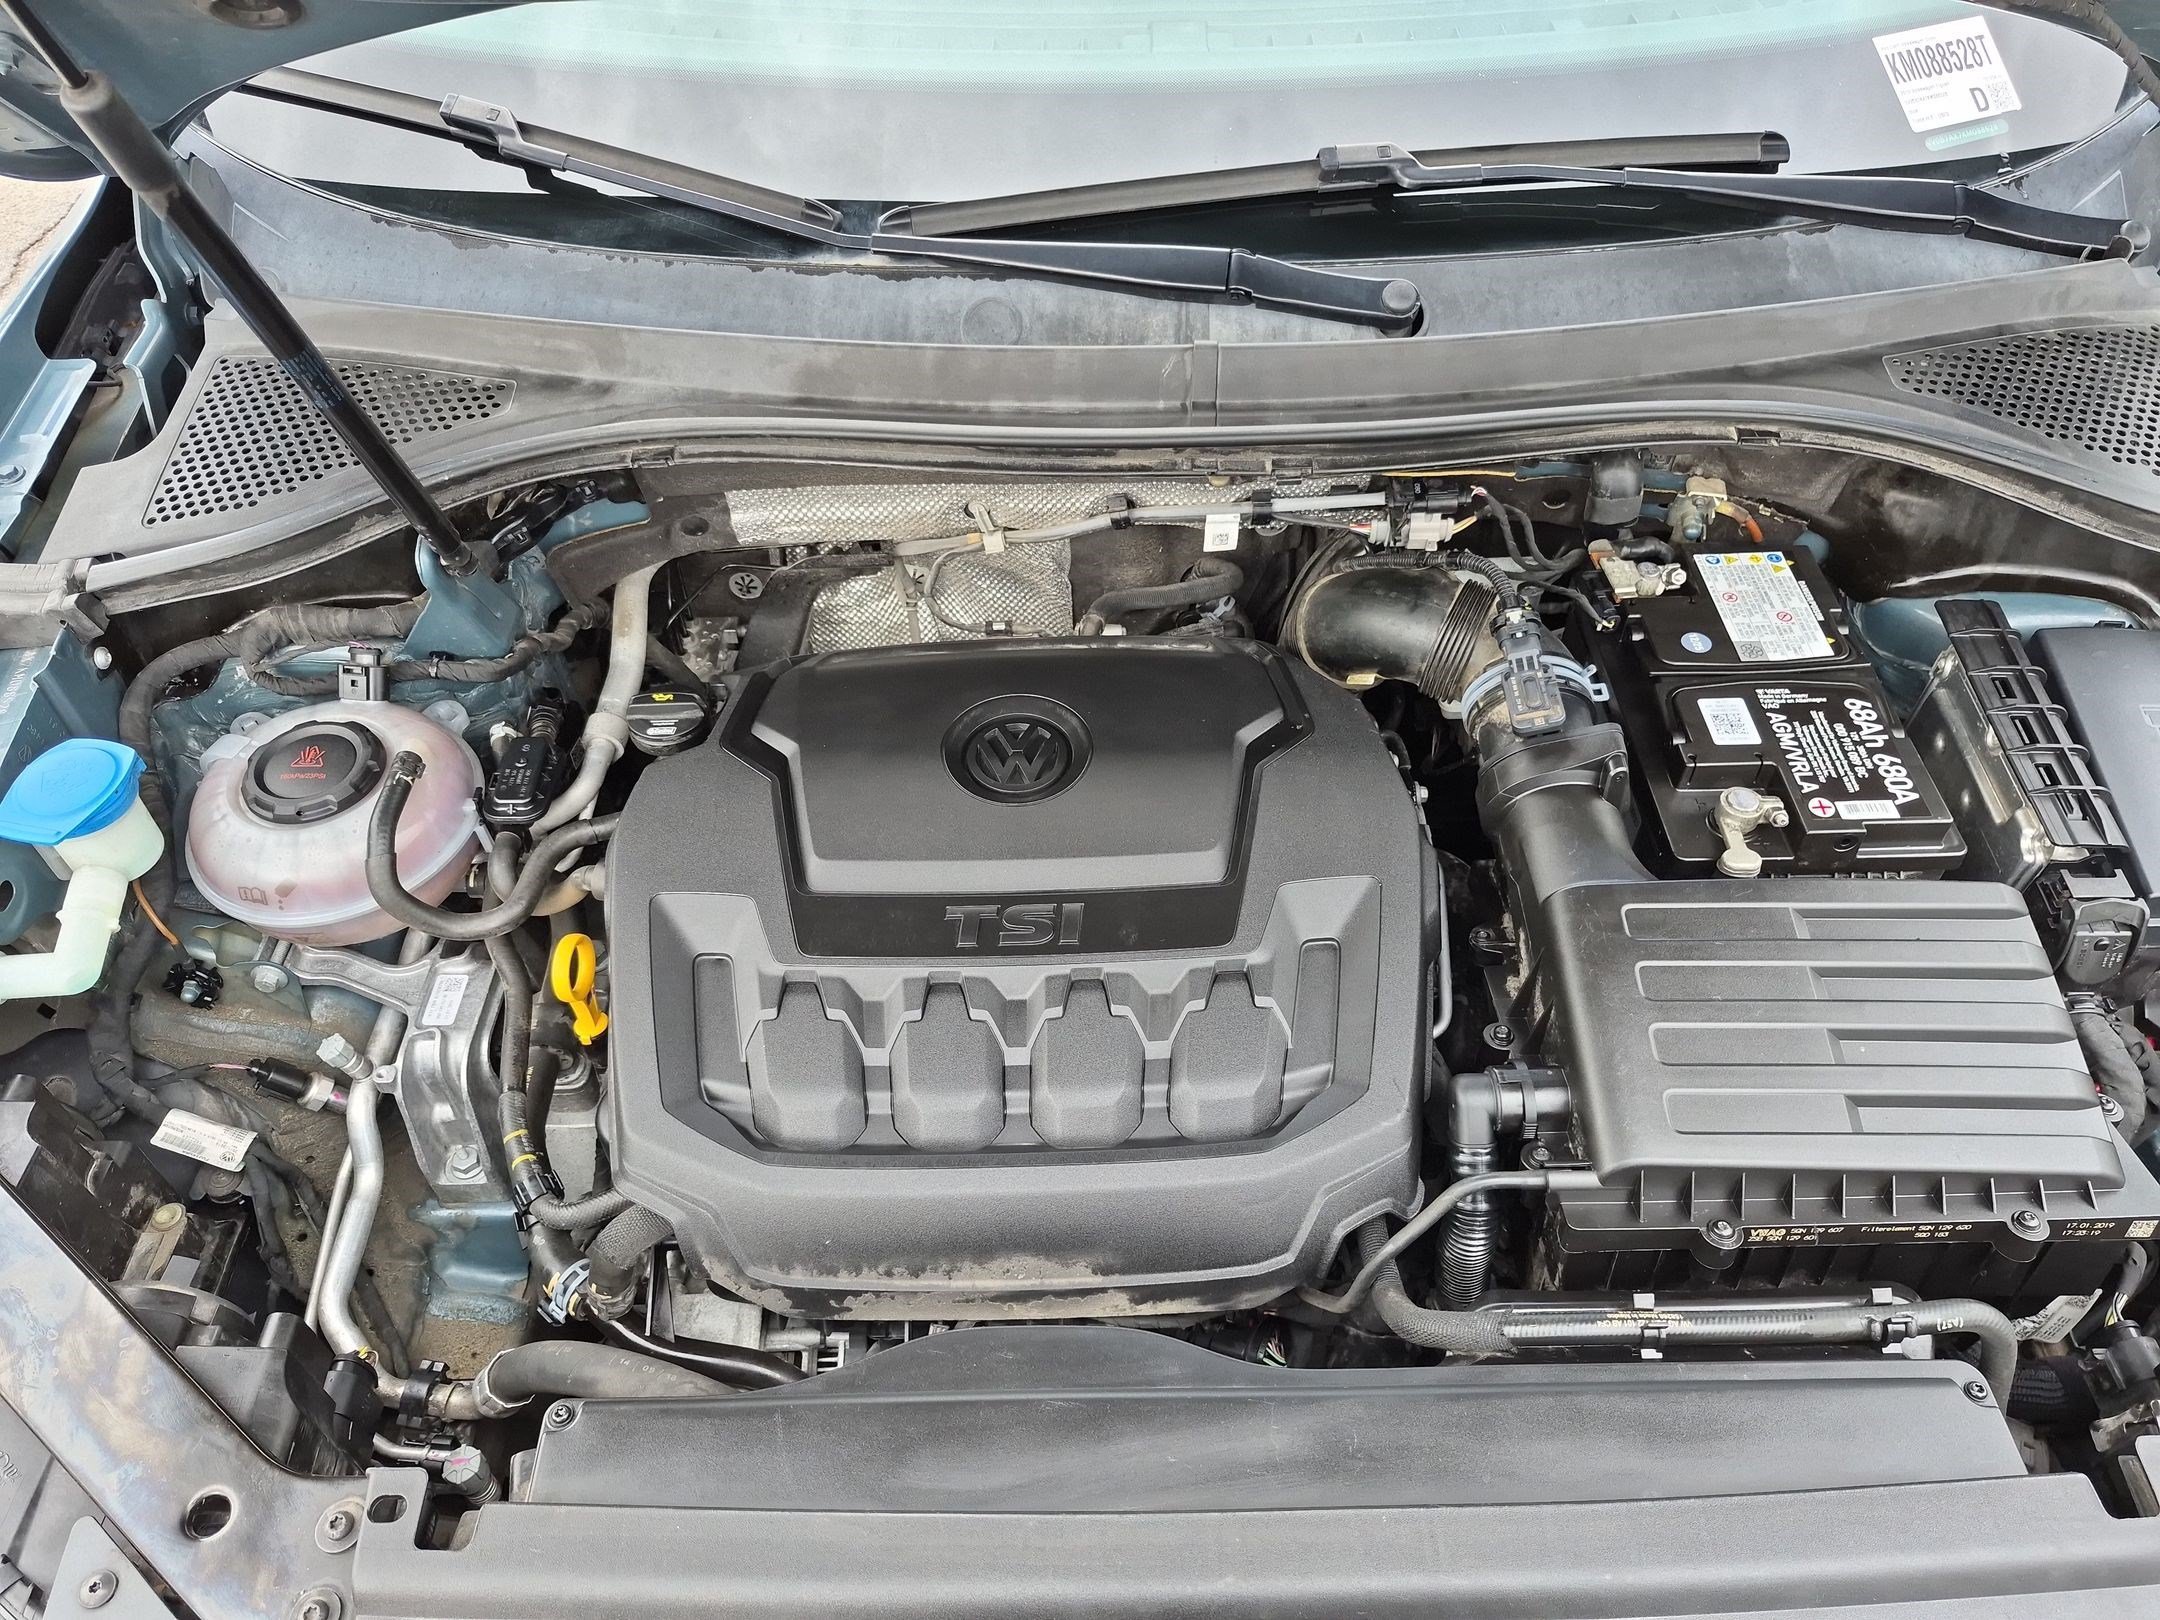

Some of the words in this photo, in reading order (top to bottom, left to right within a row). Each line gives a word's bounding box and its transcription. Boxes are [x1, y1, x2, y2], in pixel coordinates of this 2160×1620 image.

[1885, 35, 1992, 84] KM088528T
[1969, 87, 1990, 112] D
[1765, 711, 1820, 794] AGM/VRLA
[1843, 698, 1889, 748] 68Ah
[1871, 753, 1920, 806] 680A
[944, 902, 1085, 948] TSI
